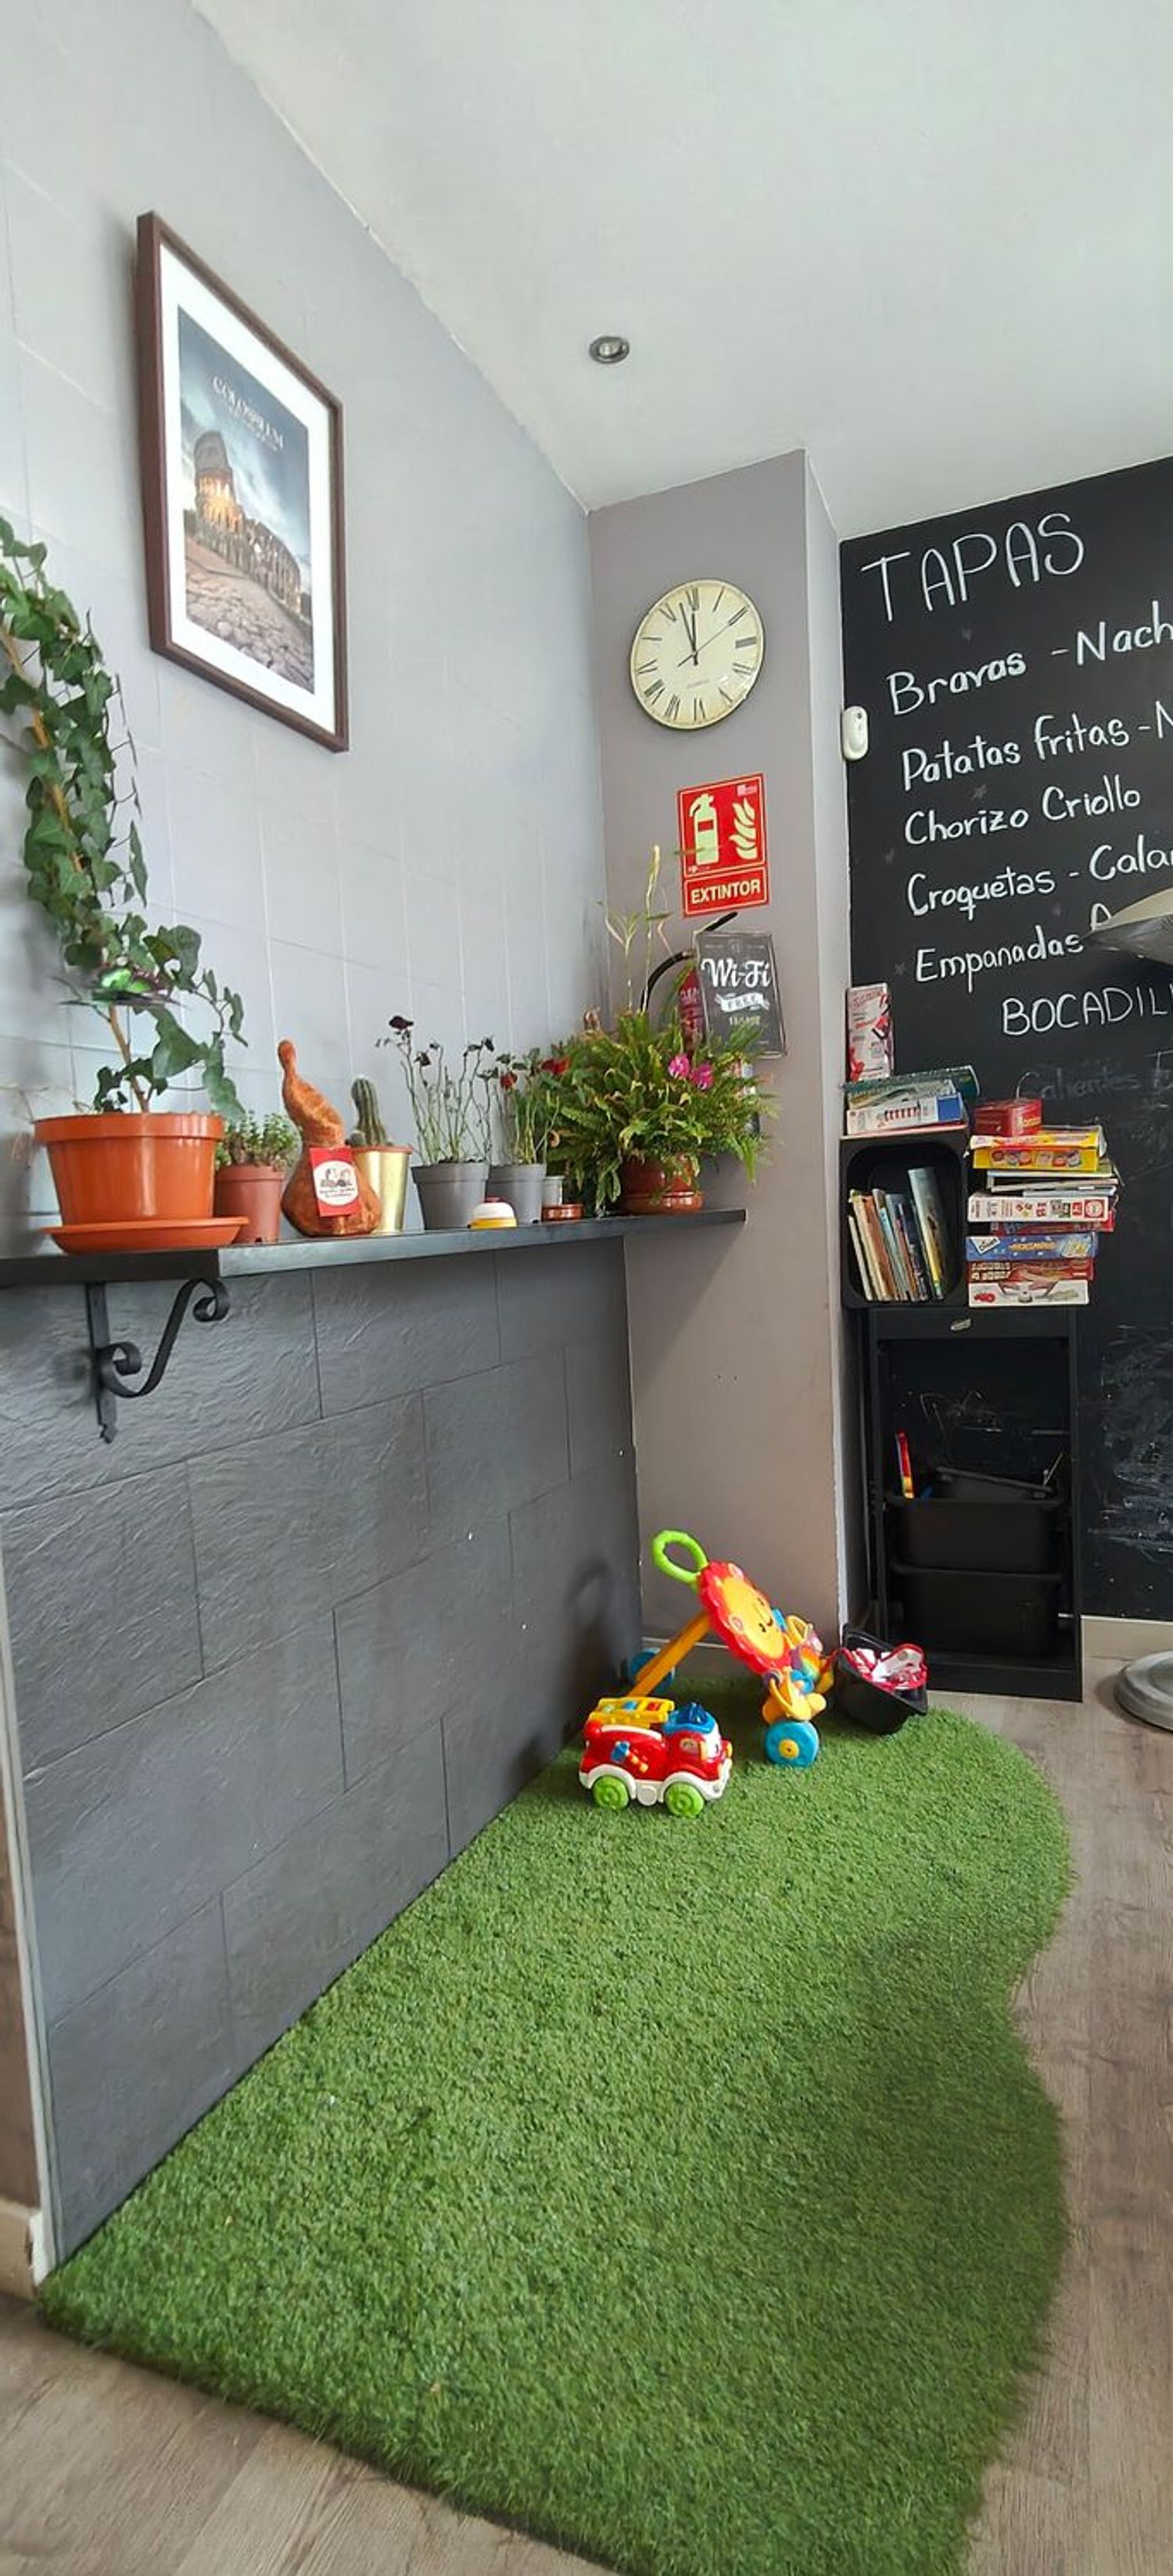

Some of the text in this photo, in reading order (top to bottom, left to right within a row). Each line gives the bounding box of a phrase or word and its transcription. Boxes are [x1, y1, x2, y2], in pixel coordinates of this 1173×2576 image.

[860, 512, 1085, 622] TAPAS
[887, 652, 1027, 716] Bravas
[902, 735, 1021, 791] Patatas
[1034, 712, 1130, 761] fritas
[905, 774, 1141, 845] Chorizo Criollo
[691, 879, 760, 904] EXTINTOR
[907, 866, 1056, 921] Croquetas
[1089, 834, 1173, 881] Cala
[701, 957, 772, 988] Wi-Fi
[916, 924, 1085, 994] Empanadas
[1001, 983, 1173, 1035] BOCADIL
